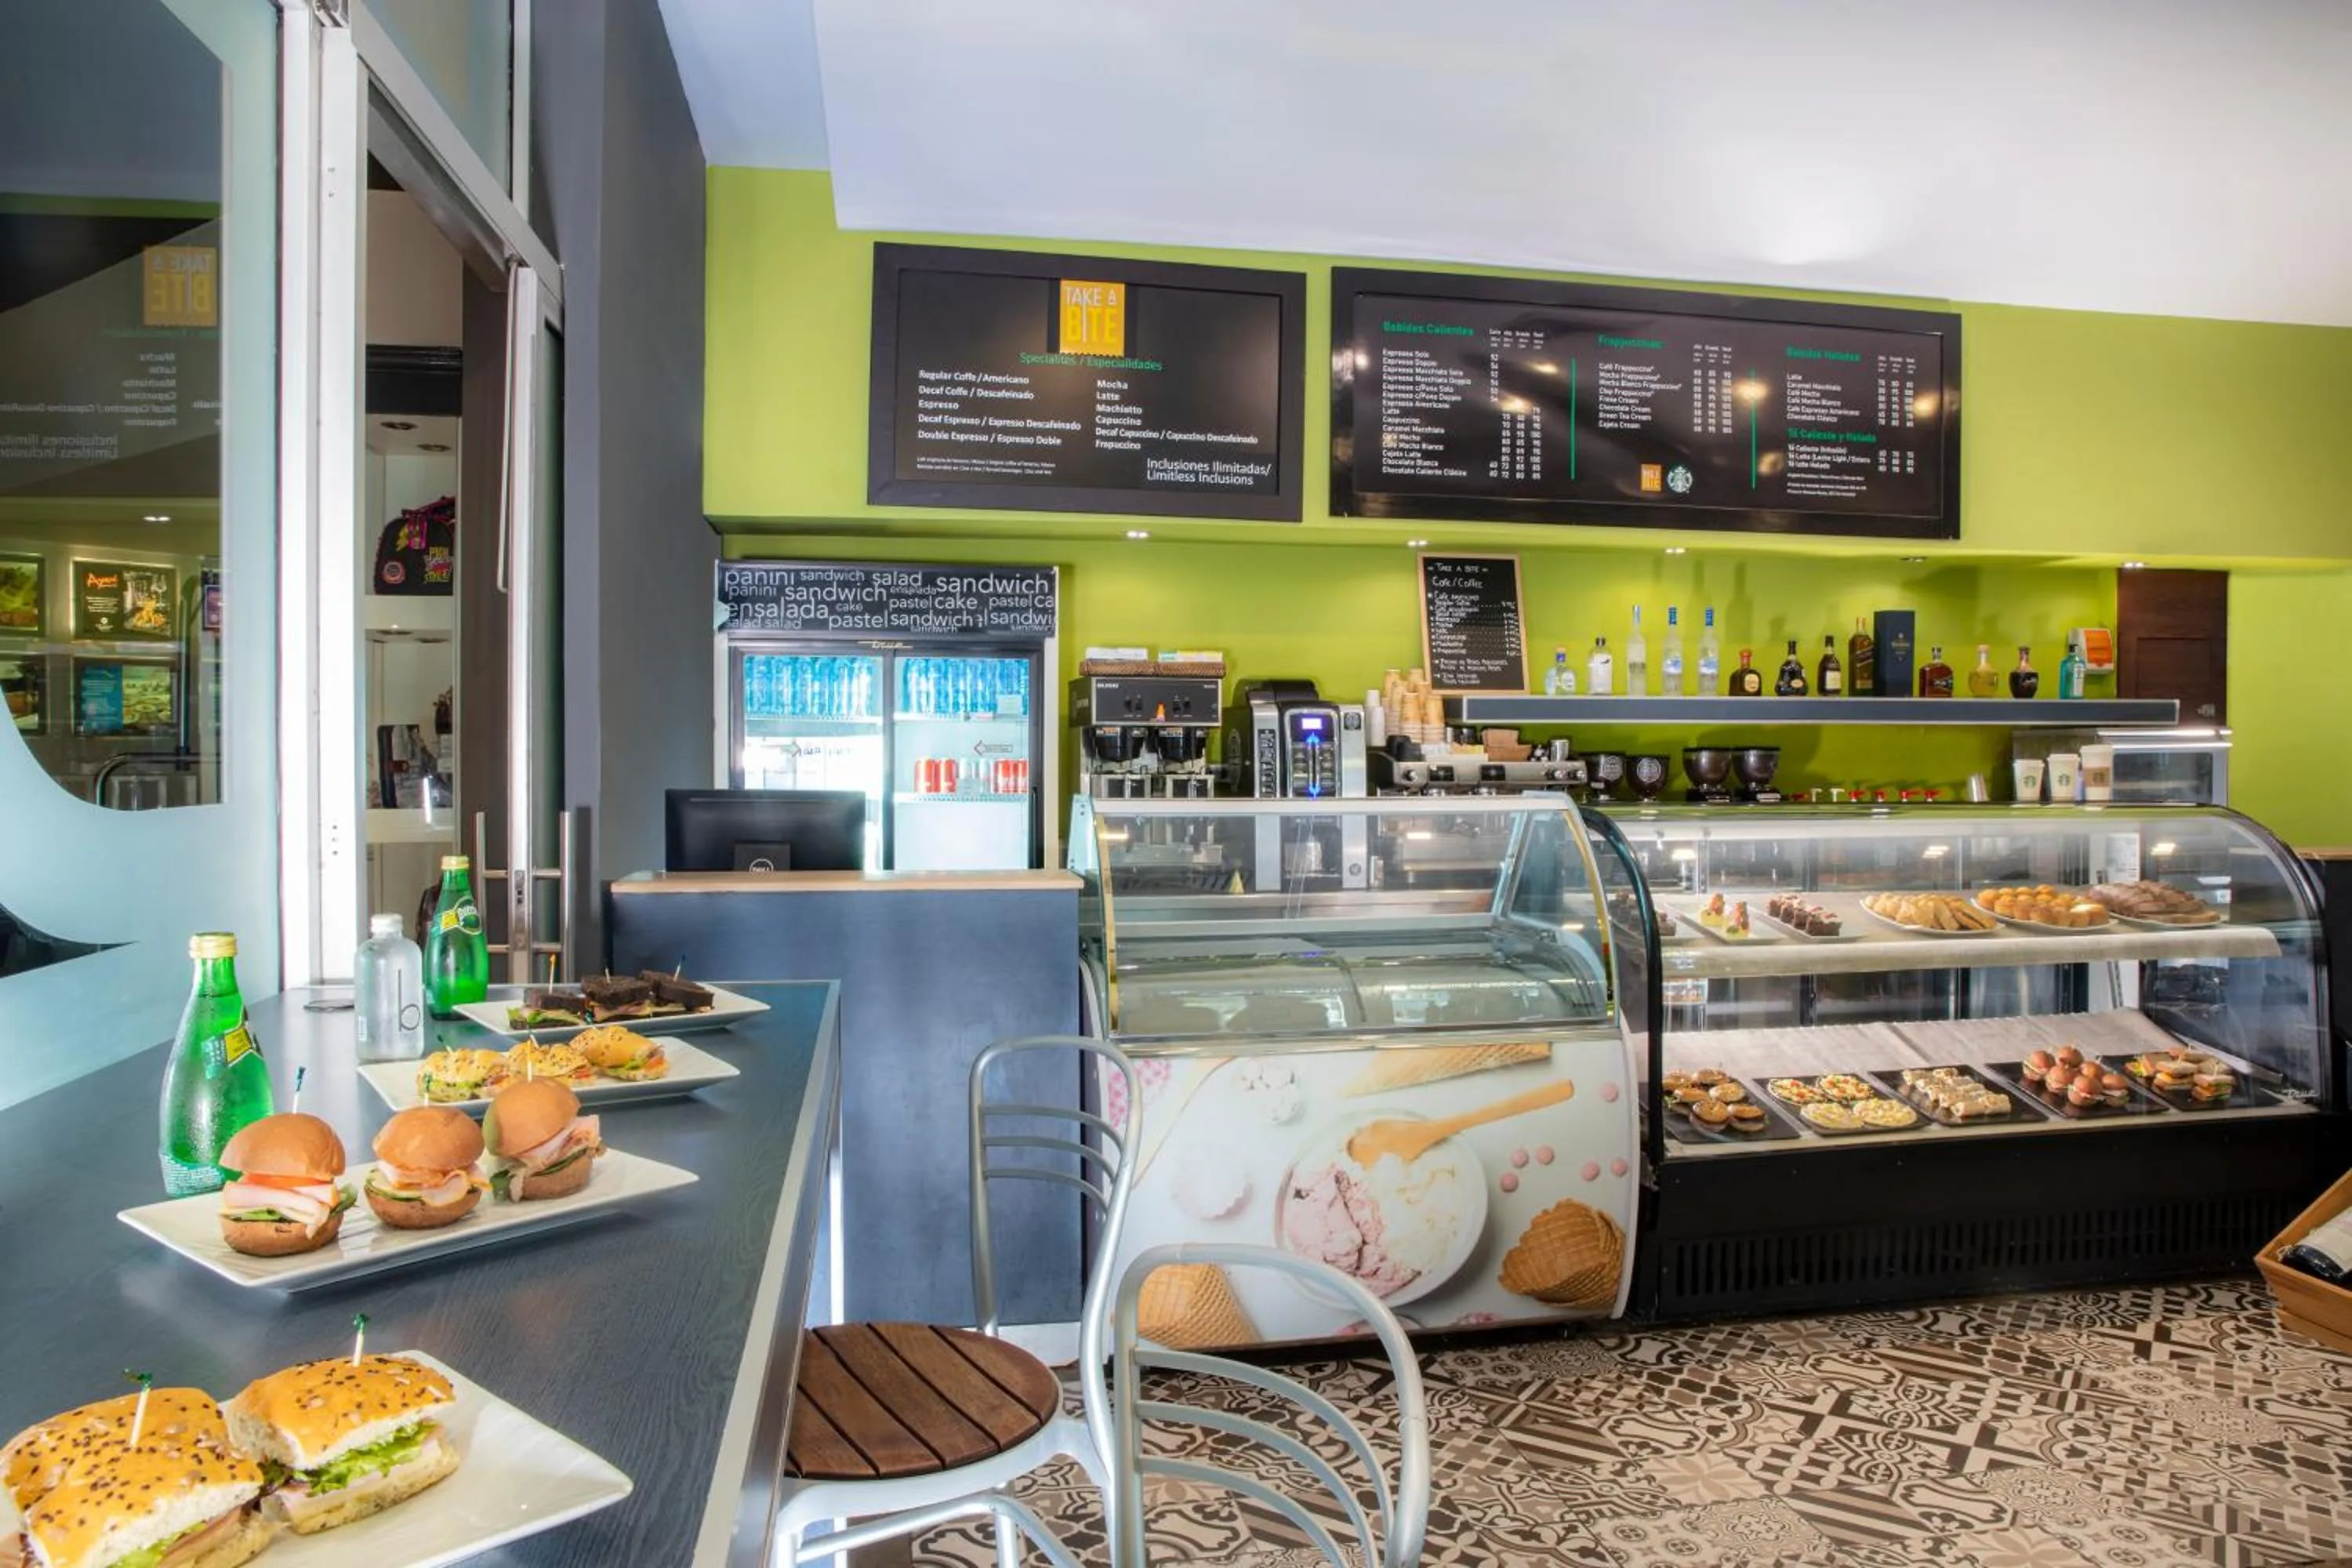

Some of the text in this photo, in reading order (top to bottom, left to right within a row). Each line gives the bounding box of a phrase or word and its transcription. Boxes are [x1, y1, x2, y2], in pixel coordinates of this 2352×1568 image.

[1064, 286, 1118, 306] TAKE A
[1065, 305, 1119, 343] BITE
[918, 369, 952, 382] Regular
[982, 373, 1029, 385] Americano
[1097, 379, 1128, 390] Mocha
[918, 385, 944, 395] Decaf
[977, 388, 1035, 400] Descafeinado
[1097, 391, 1120, 401] Latte
[918, 413, 943, 424] Decaf
[1026, 419, 1082, 431] Descafeinado
[1095, 414, 1142, 426] Capuccino
[918, 430, 949, 441] Double
[1036, 435, 1062, 447] Doble
[1095, 427, 1119, 437] Decaf
[1146, 457, 1210, 472] Inclusiones
[1146, 469, 1255, 485] Limitless Inclusions
[724, 568, 1049, 593] panini sandwich salad sandwich
[728, 583, 777, 600] panini
[784, 581, 887, 602] sandwich
[727, 596, 829, 619] ensalada
[835, 598, 863, 612] cake
[889, 595, 933, 612] pastel
[934, 592, 978, 610] cake
[989, 593, 1033, 611] pastel
[829, 609, 888, 631] pastel
[890, 610, 973, 627] sandwich
